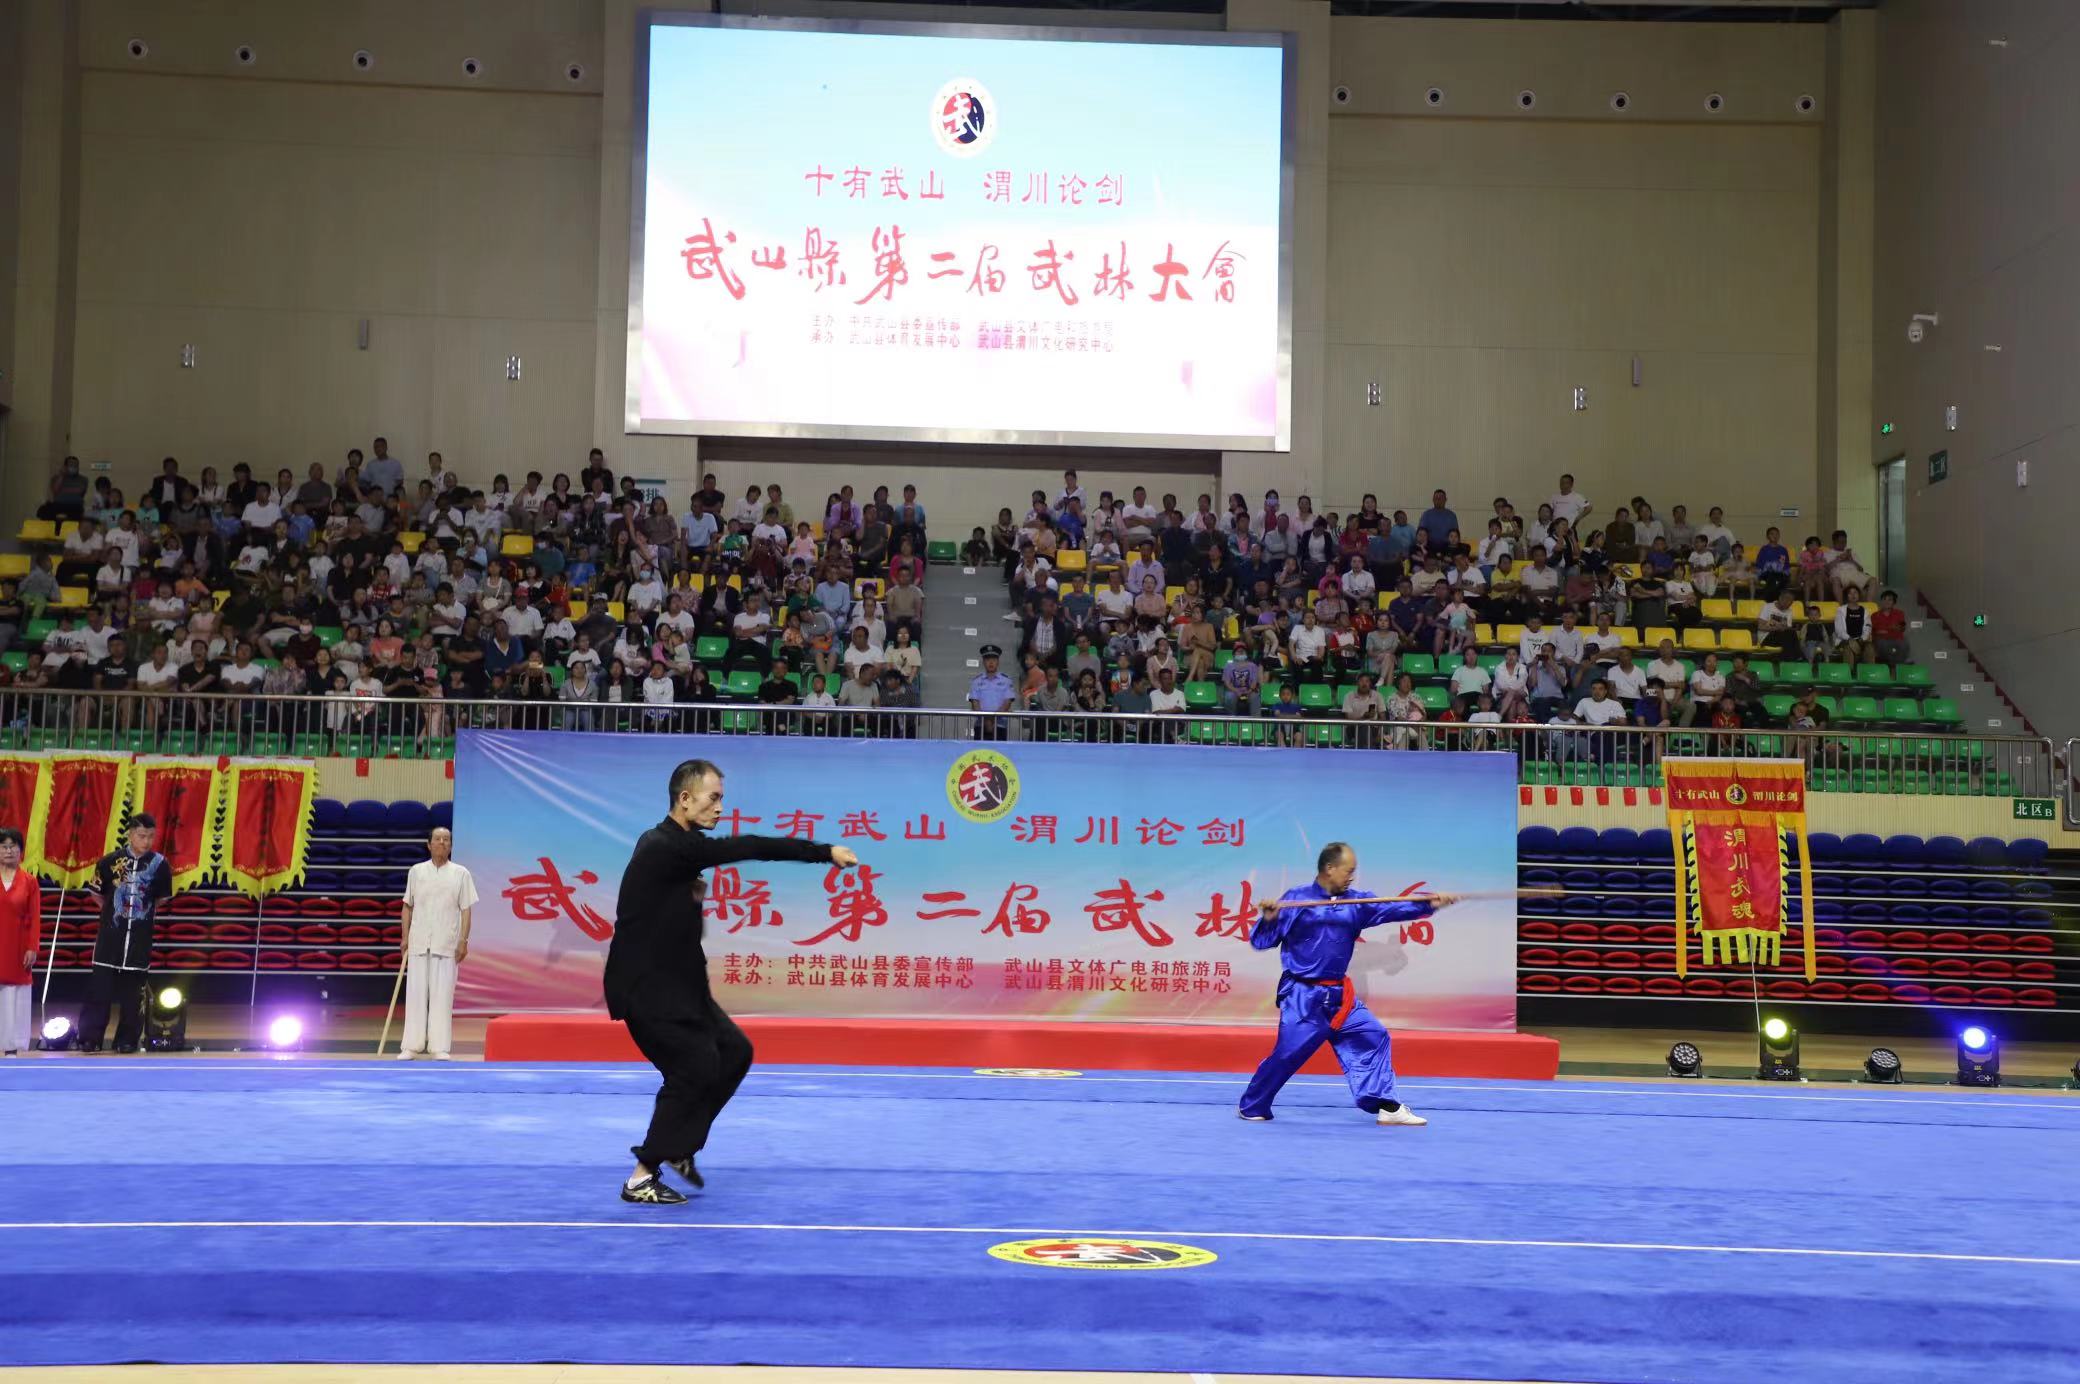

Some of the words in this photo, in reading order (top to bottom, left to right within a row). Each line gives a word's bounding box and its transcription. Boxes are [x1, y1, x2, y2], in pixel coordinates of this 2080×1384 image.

[805, 164, 945, 200] 十有武山
[983, 170, 1124, 206] 渭川论剑
[959, 763, 1004, 808] 武
[719, 808, 946, 841] 十有武山
[1010, 814, 1246, 848] 渭川论剑
[1723, 828, 1756, 920] 渭川武魂
[723, 969, 773, 985] 承办：
[787, 970, 974, 989] 武山县体育发展中心
[1004, 974, 1232, 993] 武山县渭川文化研究中心
[724, 953, 773, 969] 主办：
[787, 954, 974, 972] 中共武山县委宣传部
[1004, 957, 1232, 977] 武山县文体广电和旅游局
